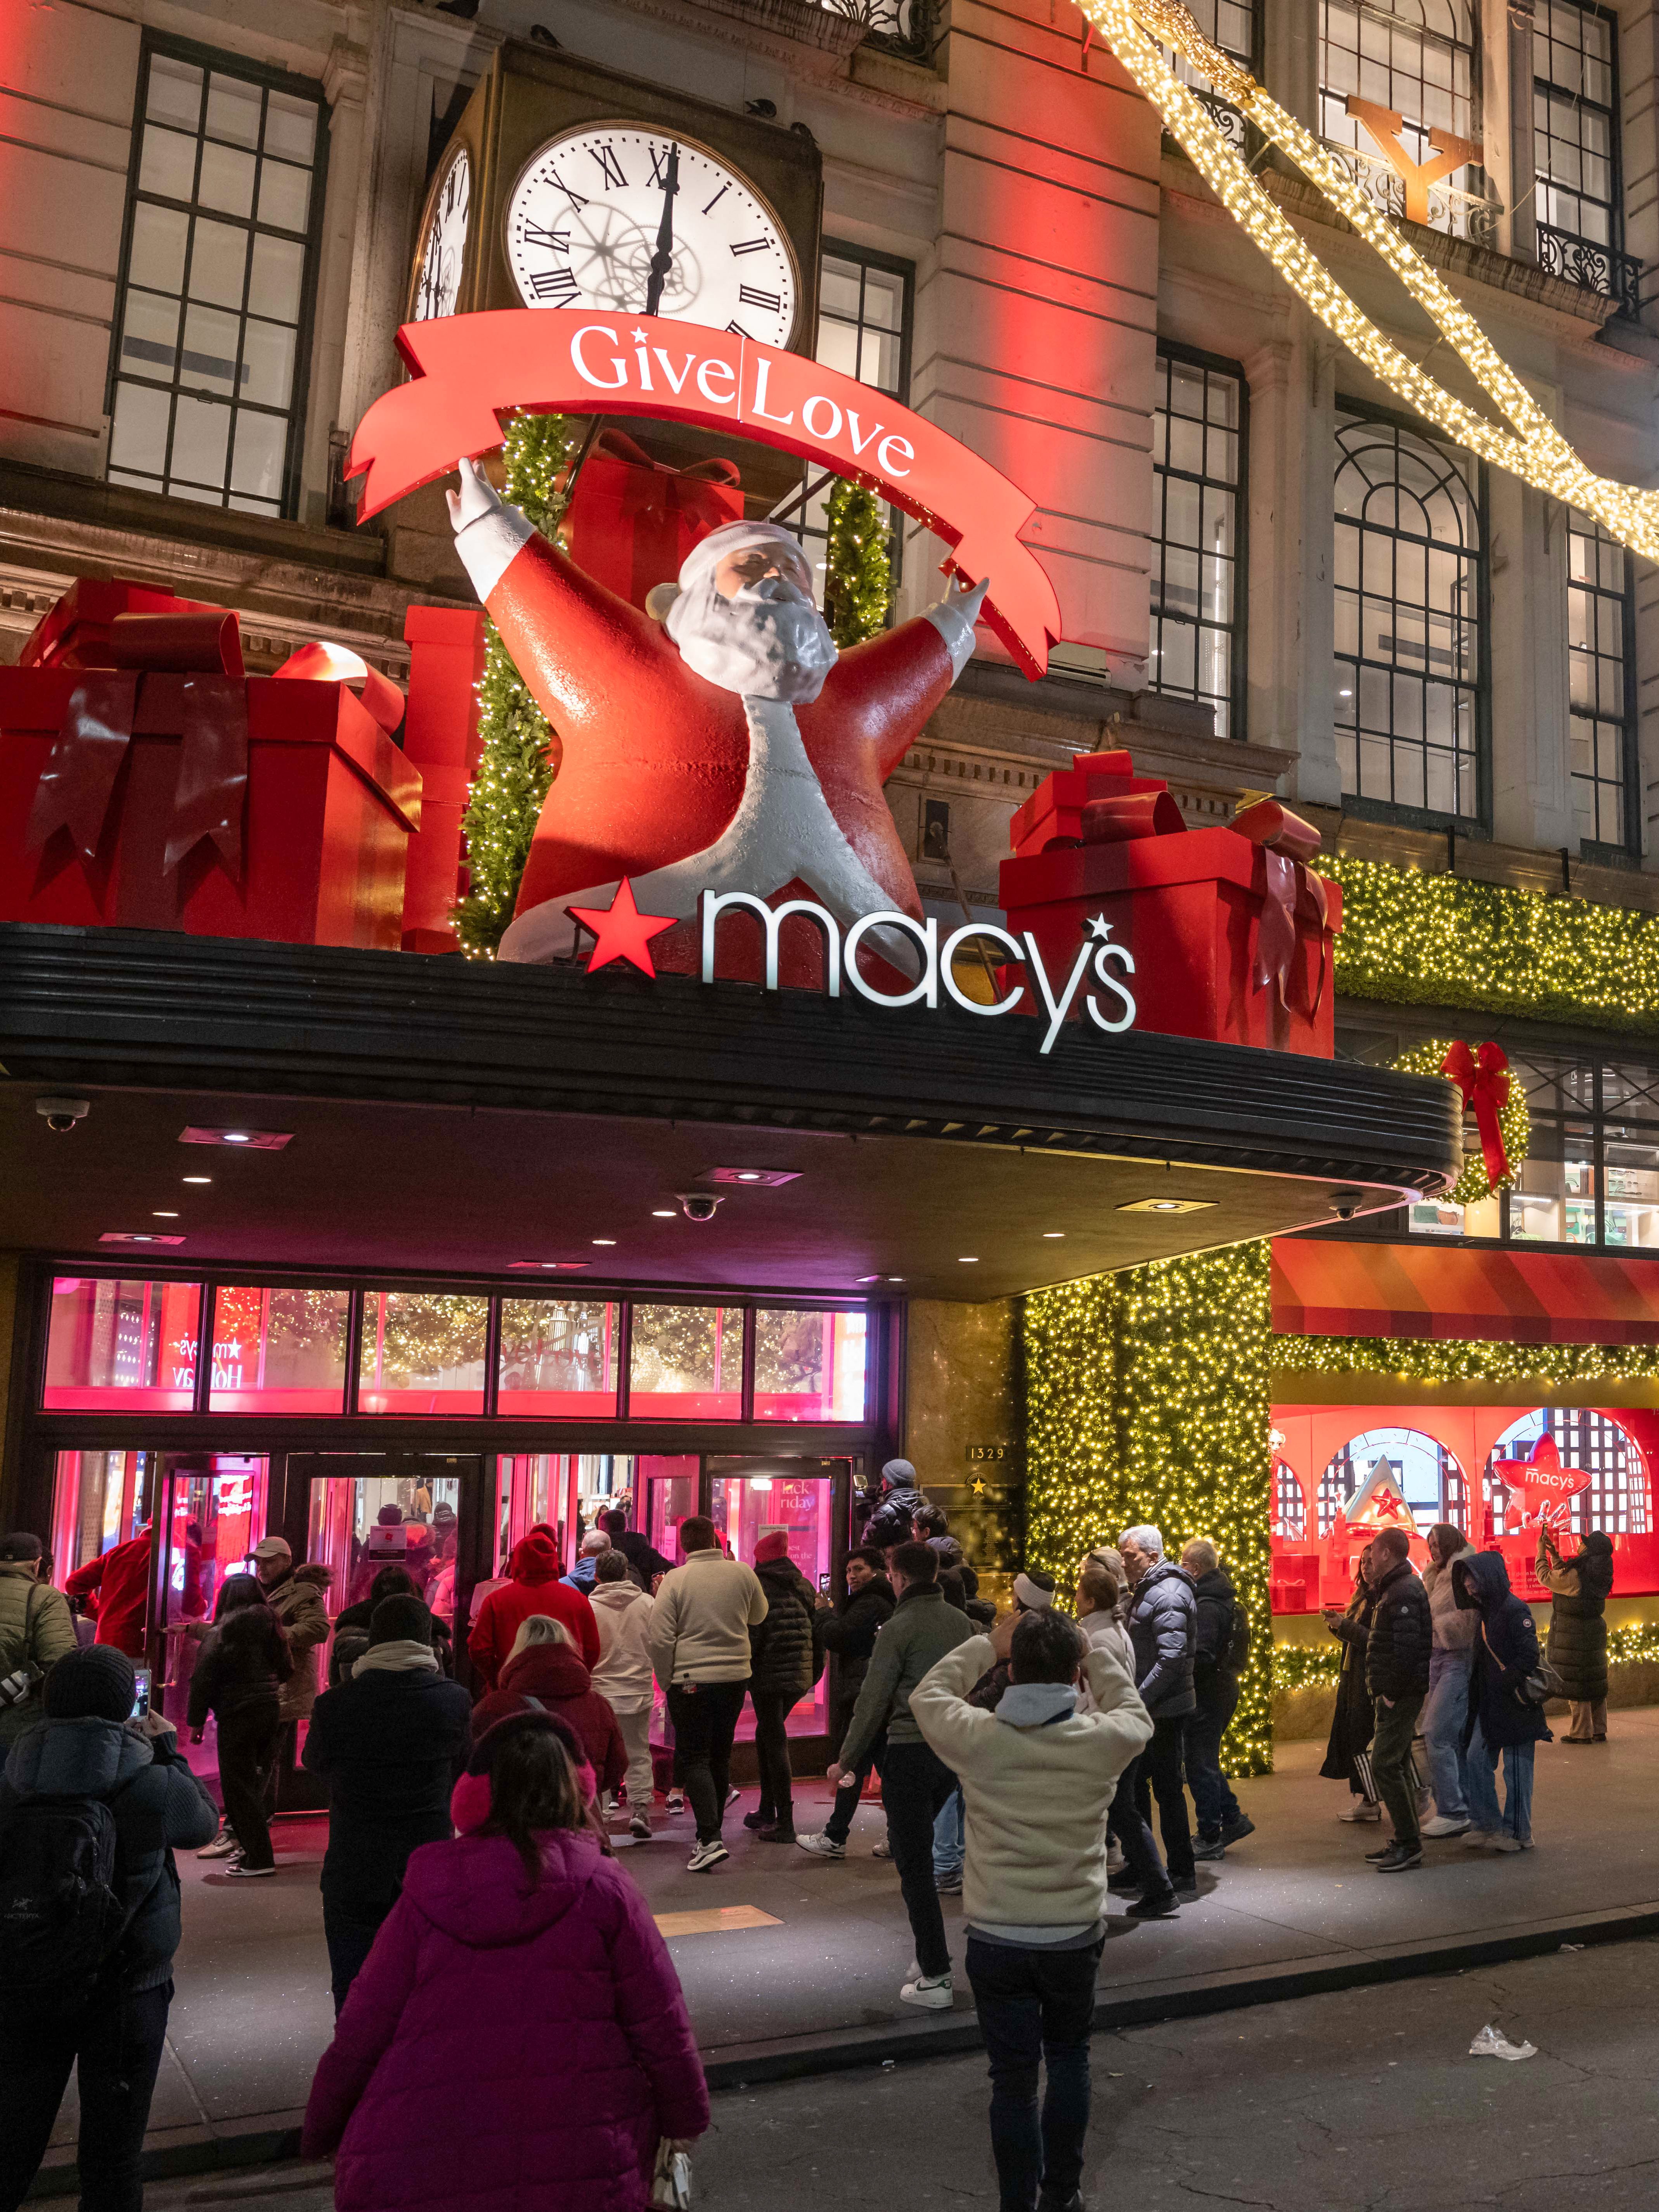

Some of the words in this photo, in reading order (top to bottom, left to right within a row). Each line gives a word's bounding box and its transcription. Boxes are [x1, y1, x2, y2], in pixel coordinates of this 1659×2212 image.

[1345, 94, 1484, 226] Y
[543, 169, 589, 213] X
[701, 185, 729, 215] I
[729, 237, 771, 256] II
[739, 284, 781, 313] III
[570, 325, 736, 404] Give
[752, 357, 914, 477] Love
[971, 1448, 1003, 1459] 1329
[781, 1481, 809, 1494] lack
[780, 1495, 815, 1511] riday
